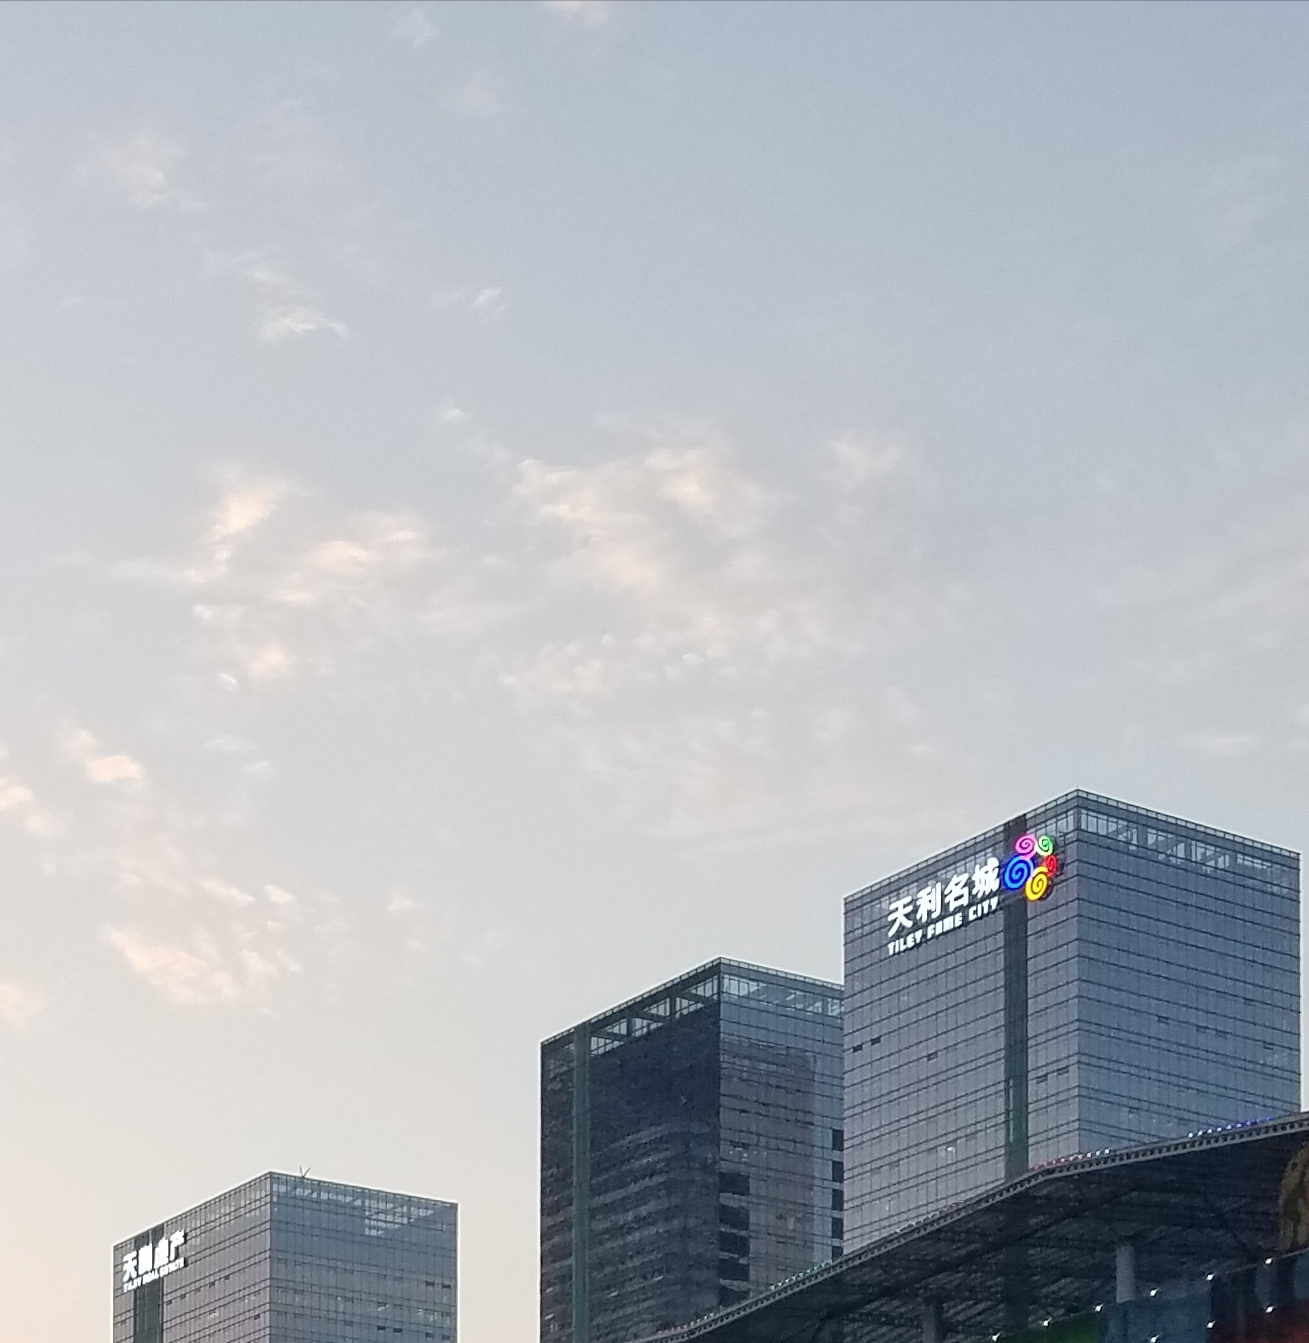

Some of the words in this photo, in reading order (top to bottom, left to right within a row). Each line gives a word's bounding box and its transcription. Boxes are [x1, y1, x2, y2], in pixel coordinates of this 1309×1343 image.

[887, 857, 1000, 937] 天利名城
[887, 929, 923, 956] TILEY
[927, 912, 963, 939] FAME
[968, 896, 998, 921] CITY
